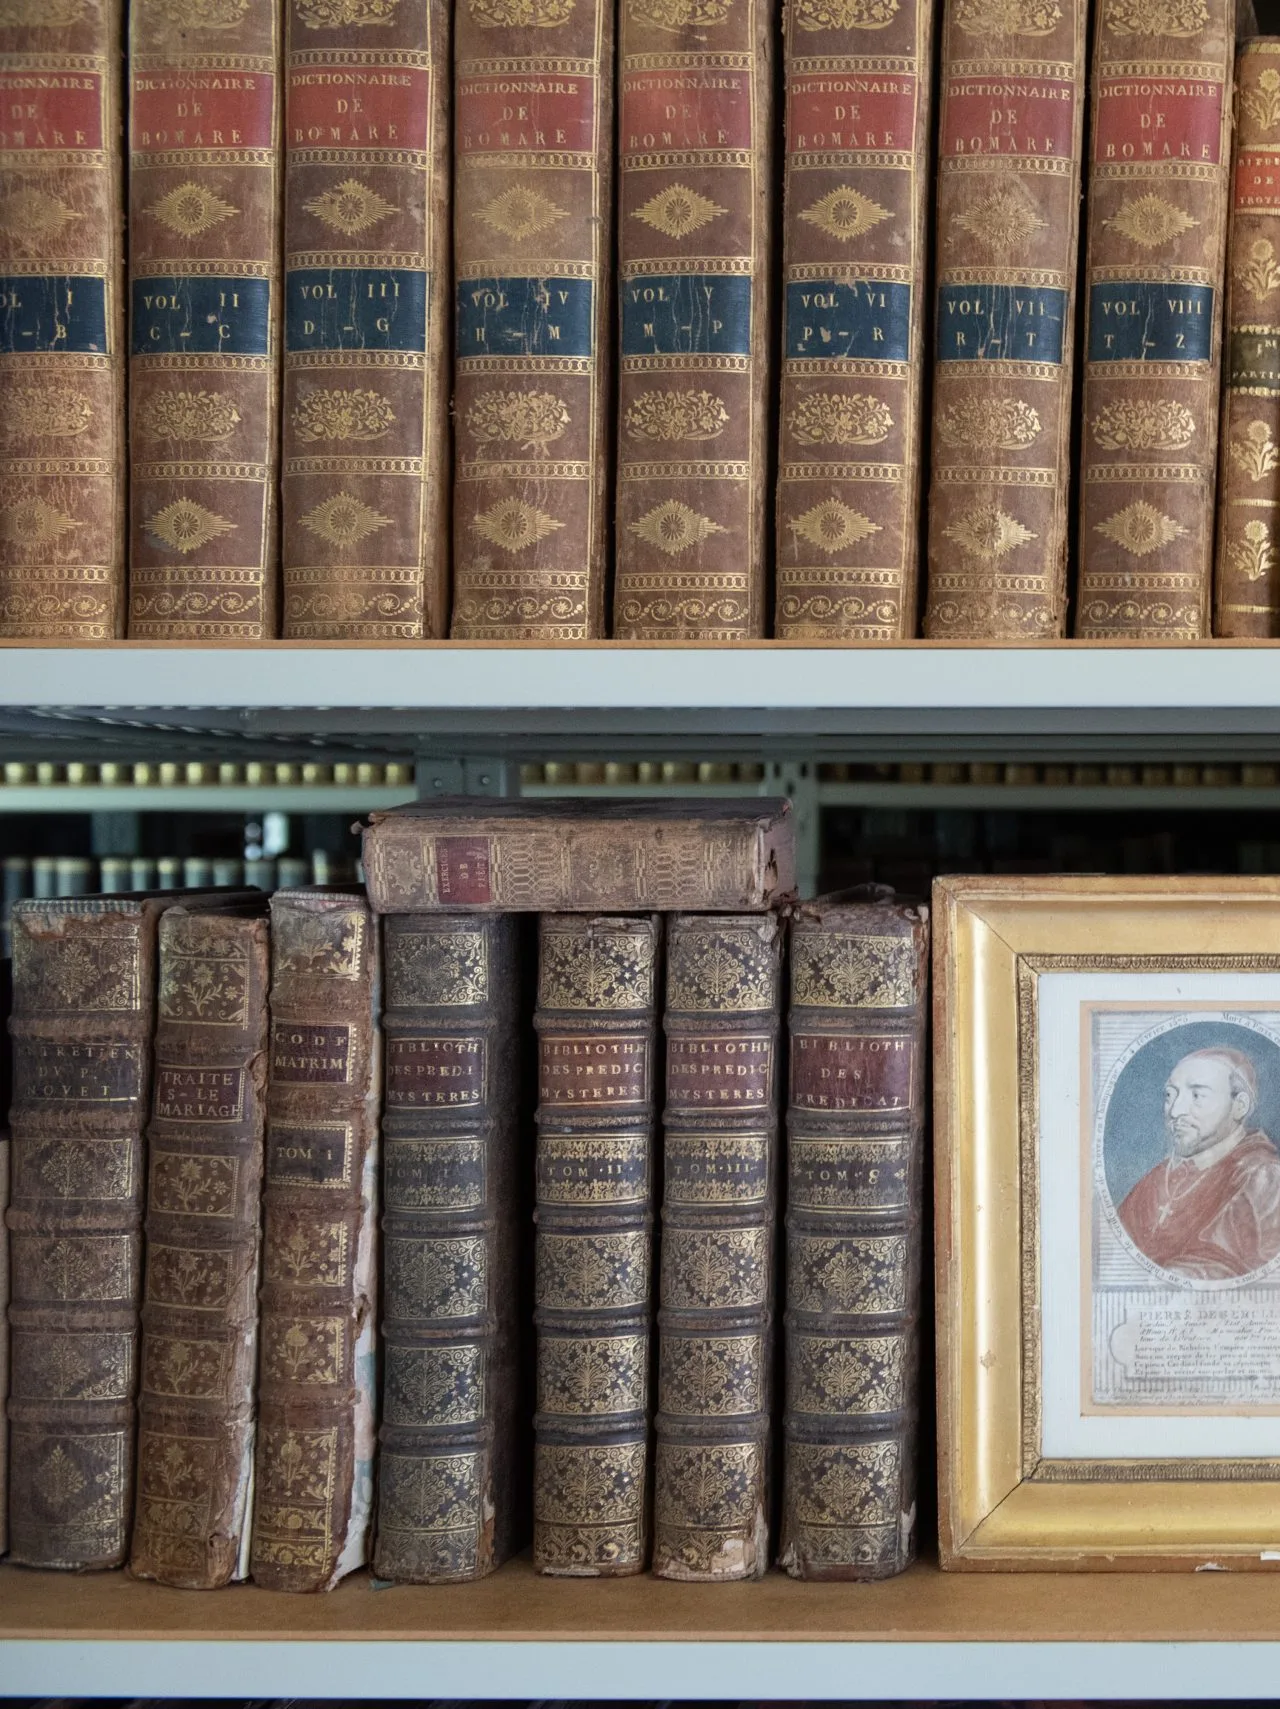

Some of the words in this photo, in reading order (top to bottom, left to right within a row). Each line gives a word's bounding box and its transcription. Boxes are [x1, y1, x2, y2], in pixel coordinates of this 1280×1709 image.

[0, 78, 95, 91] TIONNAIRE
[135, 78, 256, 92] DICTIONNAIRE
[291, 74, 412, 87] DICTIONNAIRE
[624, 77, 741, 92] DICTIONNAIRE
[792, 80, 912, 95] DICTIONNAIRE
[460, 82, 579, 96] DICTIONNAIRE
[949, 84, 1071, 100] DICTIONNAIRE
[1100, 84, 1218, 99] DICTIONNAIRE
[11, 104, 38, 120] DE
[177, 102, 203, 118] DE
[337, 98, 363, 114] DE
[502, 106, 528, 121] DE
[665, 104, 692, 120] DE
[835, 105, 861, 120] DE
[991, 109, 1017, 125] DE
[1140, 113, 1166, 129] DE
[142, 129, 243, 146] BOMARE
[295, 124, 398, 142] BOMARE
[463, 129, 567, 148] BOMARE
[630, 129, 729, 148] BOMARE
[797, 131, 895, 148] BOMARE
[955, 136, 1055, 153] BOMARE
[1106, 142, 1211, 160] BOMARE
[1254, 176, 1274, 185] DE
[301, 283, 337, 300] VOL
[367, 282, 400, 299] III
[632, 287, 670, 303] VOL
[703, 286, 714, 300] V
[144, 294, 181, 311] VOL
[219, 292, 240, 308] II
[472, 292, 509, 308] VOL
[544, 290, 569, 306] IV
[801, 293, 839, 308] VOL
[866, 292, 886, 308] VI
[948, 300, 984, 316] VOL
[1016, 300, 1045, 316] VII
[1102, 301, 1140, 316] VOL
[800, 1040, 904, 1052] BIBLIOTH
[162, 1071, 233, 1086] TRAITE
[820, 1067, 862, 1080] DES
[542, 1085, 641, 1099] MYSTERES
[669, 1087, 765, 1100] MYSTERES
[160, 1103, 242, 1117] MARIAGE
[278, 1147, 312, 1160] TOM
[548, 1166, 589, 1178] TOM
[806, 1170, 848, 1181] TOM
